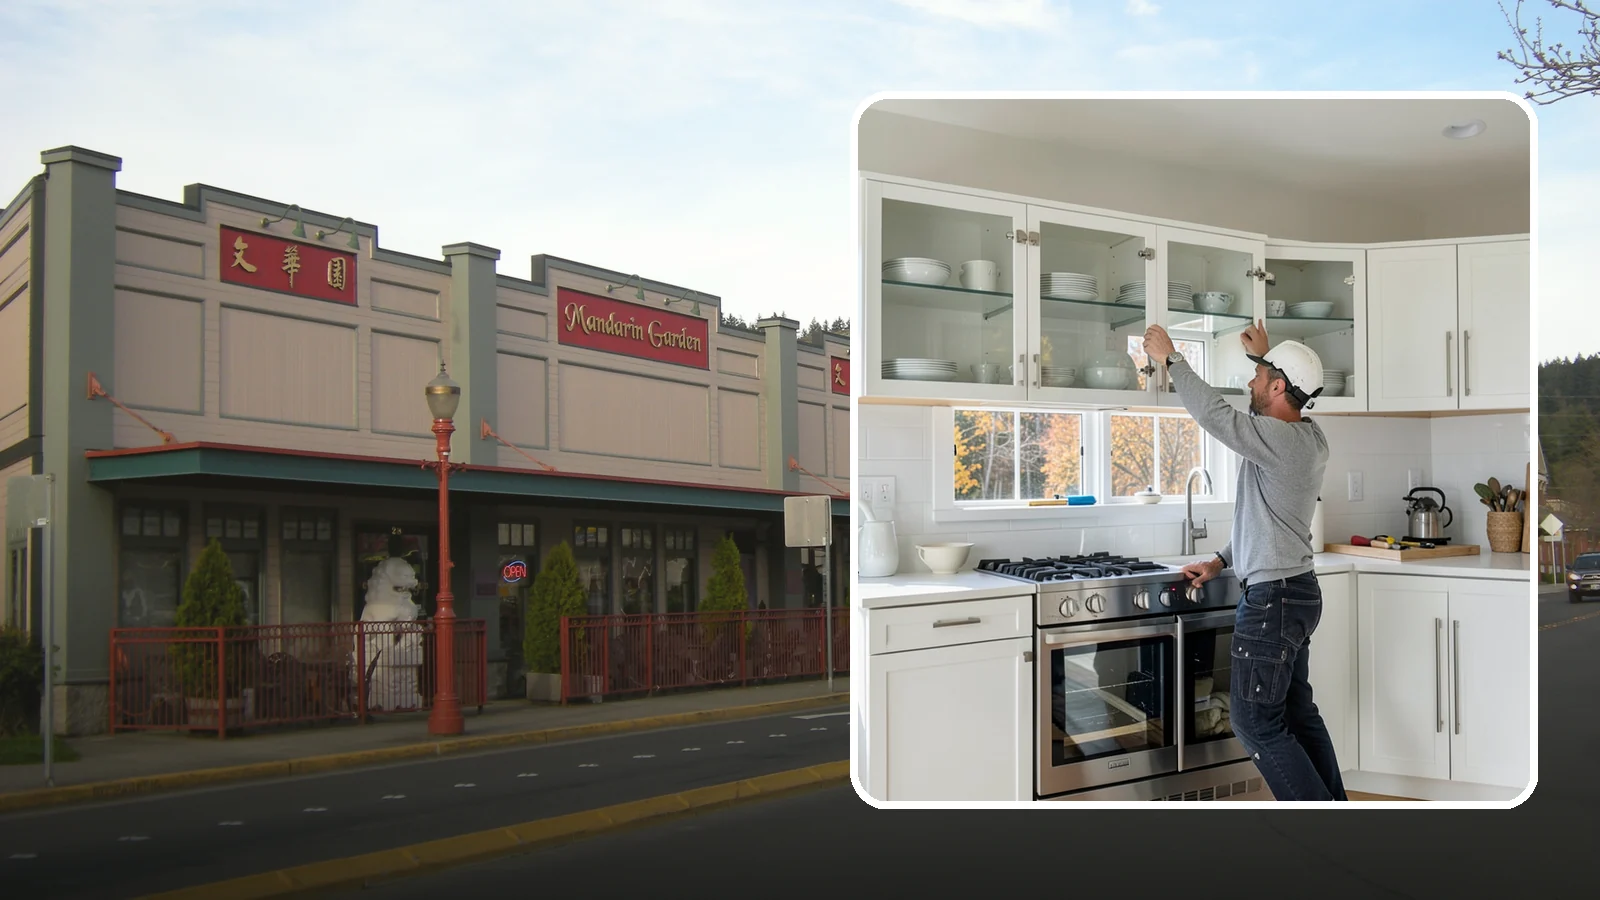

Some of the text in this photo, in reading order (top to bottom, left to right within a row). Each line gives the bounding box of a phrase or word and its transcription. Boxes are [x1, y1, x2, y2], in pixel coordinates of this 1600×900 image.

[231, 235, 346, 291] 文華園
[565, 302, 701, 353] Mandarin Garden
[503, 565, 527, 578] OPEN
